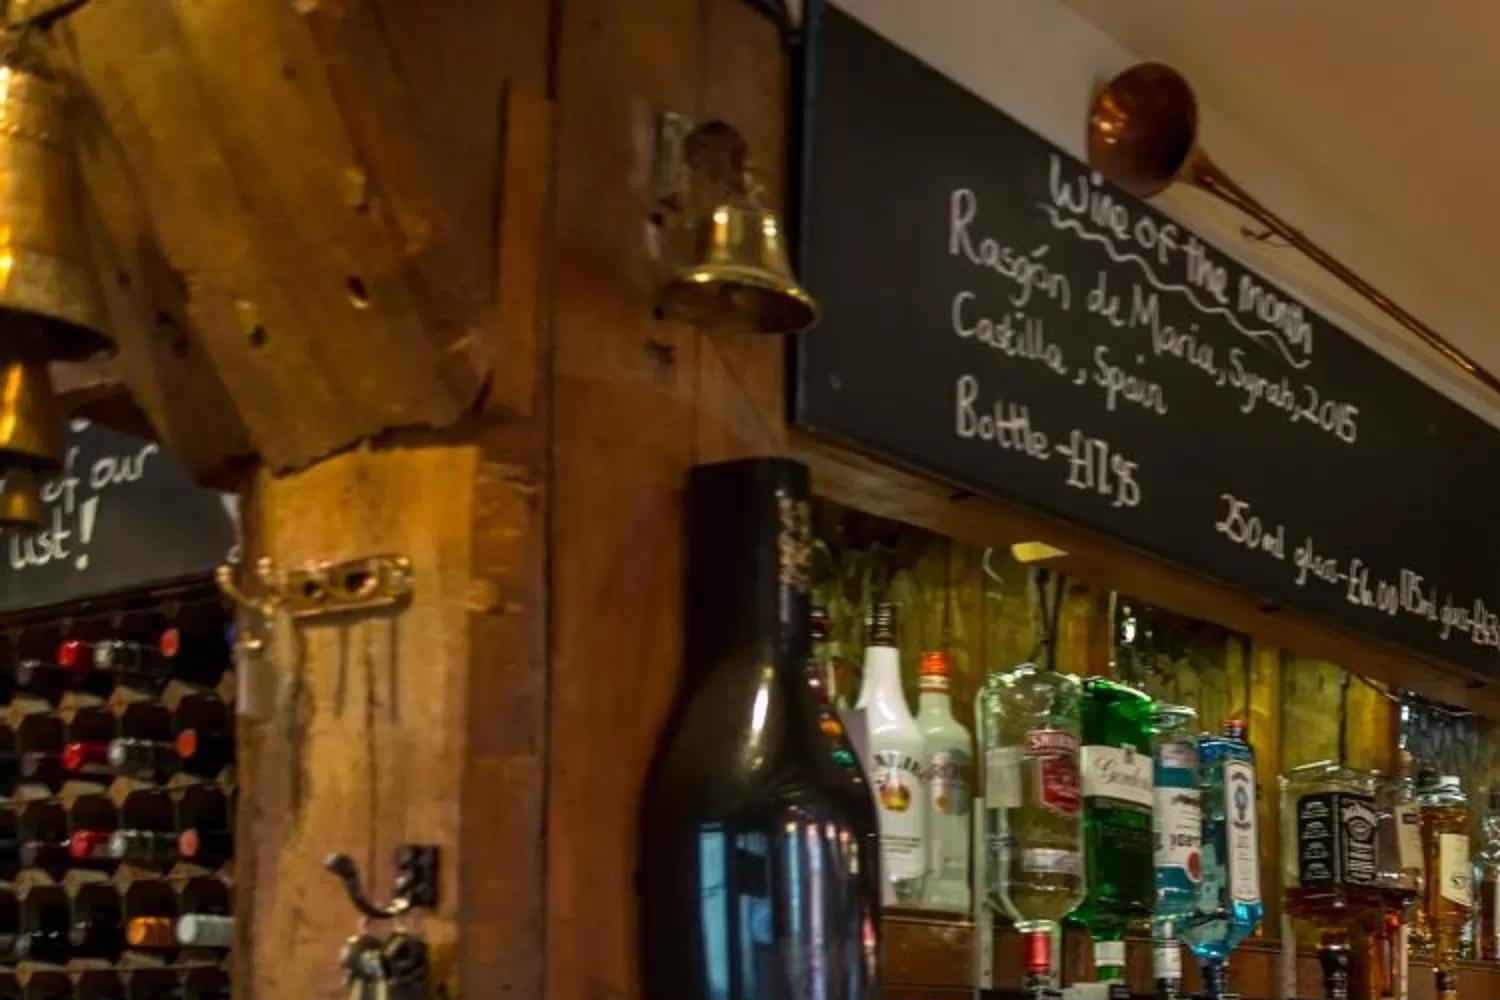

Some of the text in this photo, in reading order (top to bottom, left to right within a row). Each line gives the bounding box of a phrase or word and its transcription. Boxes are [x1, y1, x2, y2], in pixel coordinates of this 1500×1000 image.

[1048, 153, 1314, 356] Wine of the month
[1086, 269, 1125, 328] de
[954, 373, 1051, 461] Bottle
[1092, 343, 1169, 415] Spain
[39, 439, 161, 517] of our
